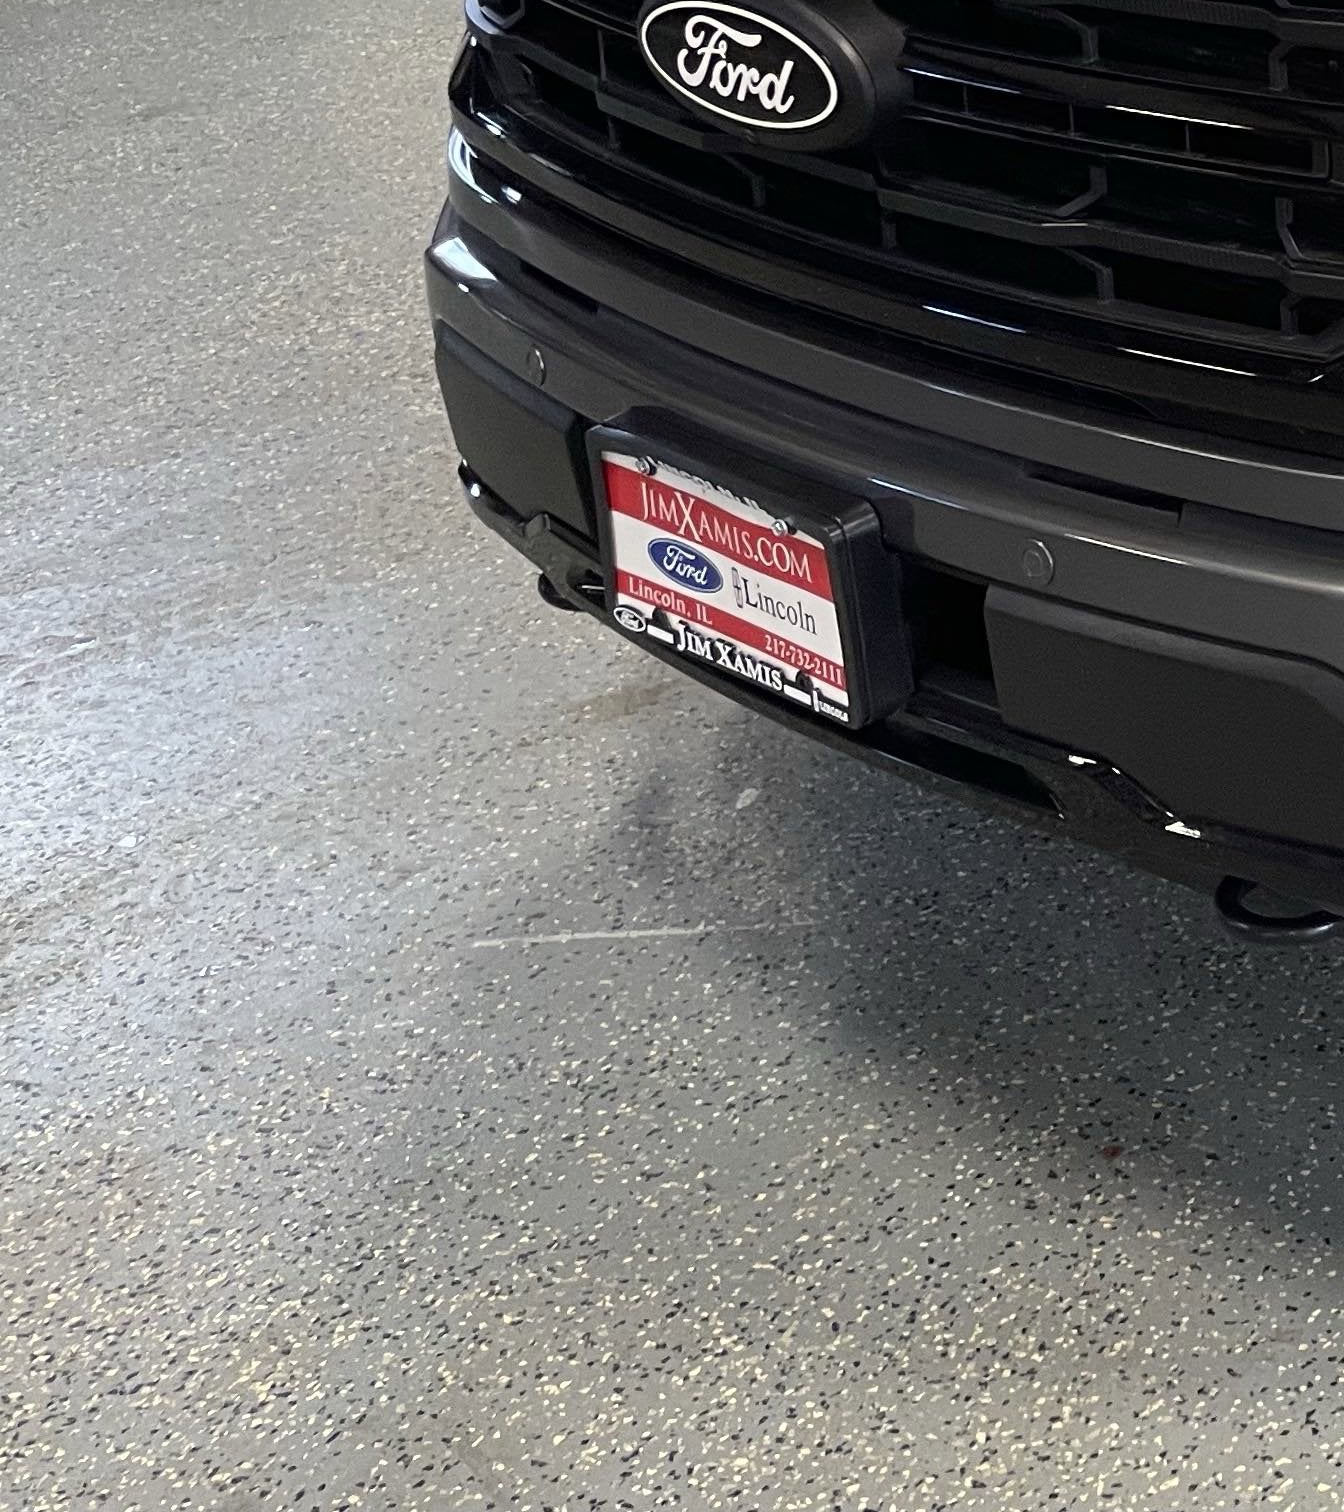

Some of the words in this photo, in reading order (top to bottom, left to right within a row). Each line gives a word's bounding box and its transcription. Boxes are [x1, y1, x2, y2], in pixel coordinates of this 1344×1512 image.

[676, 14, 795, 115] Ford
[640, 482, 812, 584] JIMXAMIS.COM
[662, 543, 708, 586] Ford
[696, 603, 713, 626] IL
[741, 577, 818, 636] Lincoln
[676, 618, 714, 662] JIM
[714, 641, 783, 692] XAMIS
